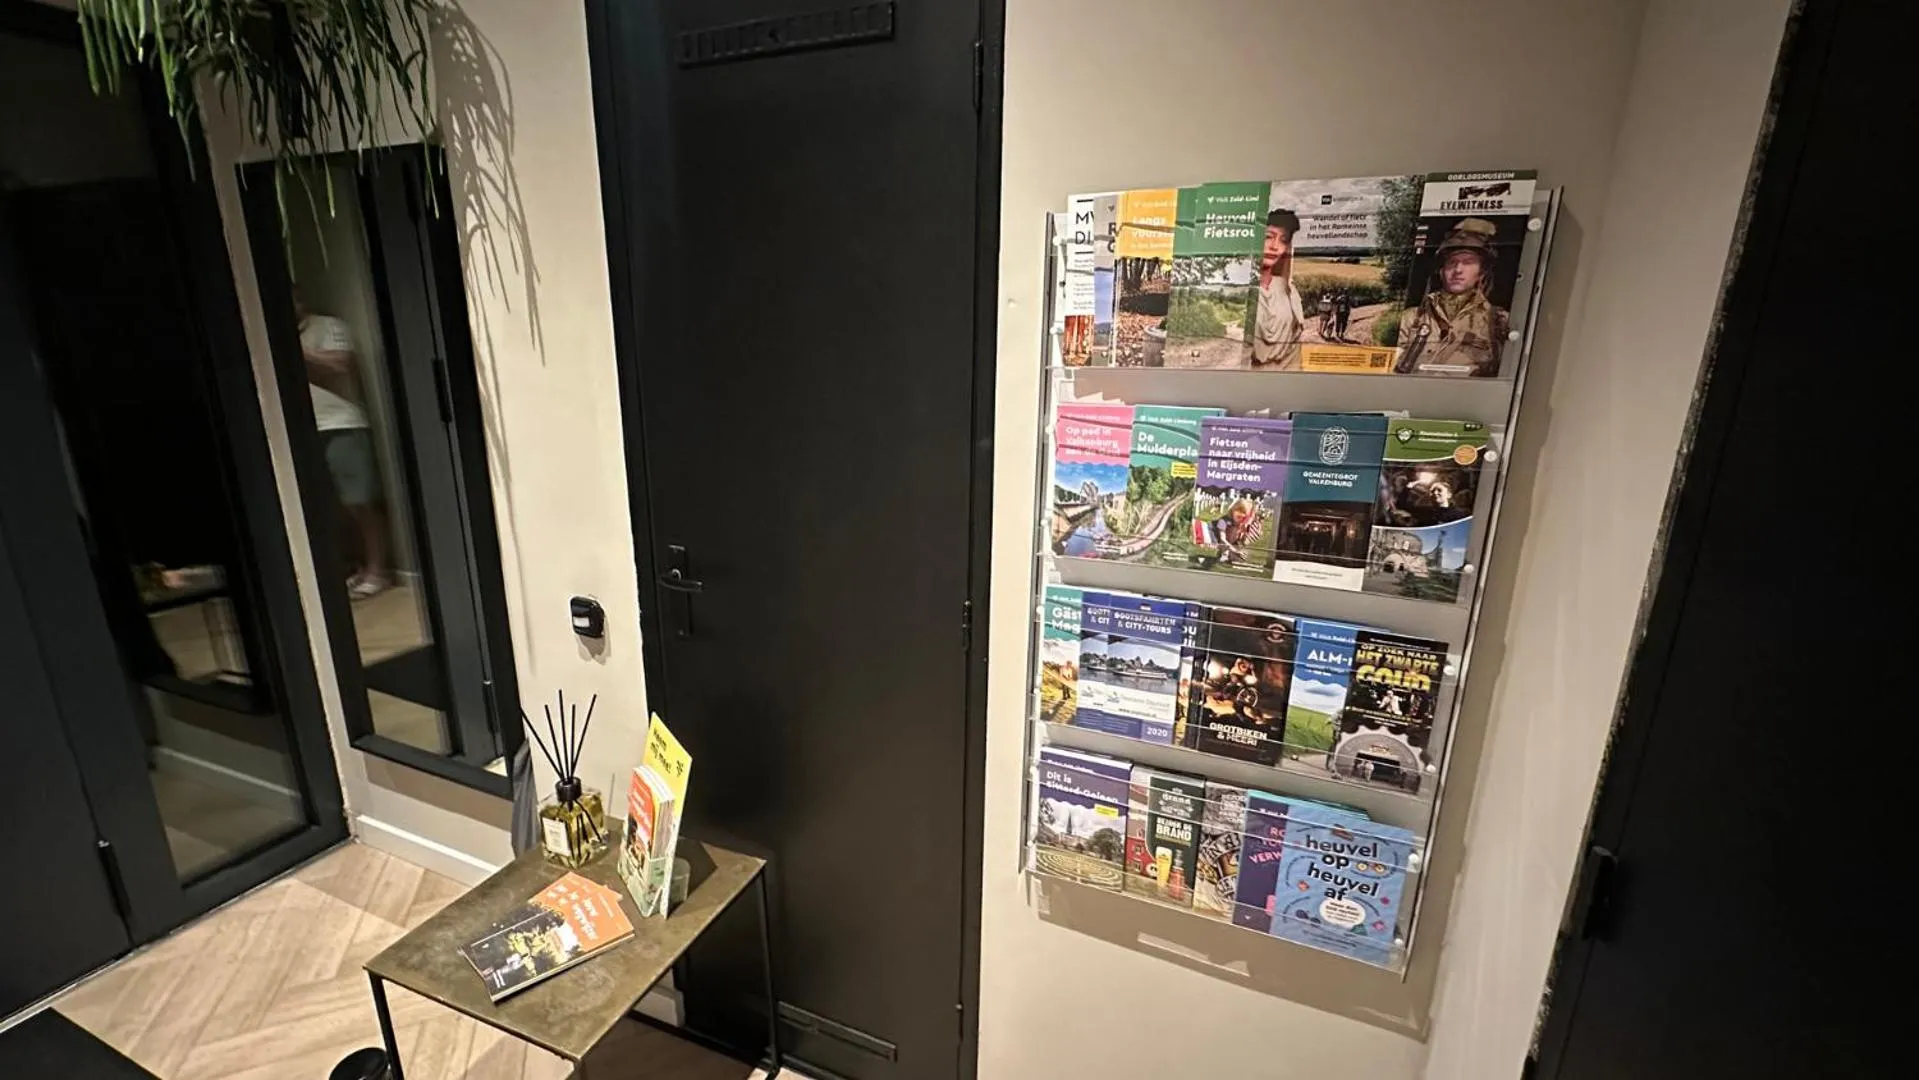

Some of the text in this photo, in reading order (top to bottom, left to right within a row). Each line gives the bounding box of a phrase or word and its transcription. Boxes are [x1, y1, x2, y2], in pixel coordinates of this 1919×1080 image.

[1447, 172, 1516, 181] OORLOGSMUSEUM
[1440, 199, 1504, 211] EYEWITNESS
[1205, 211, 1256, 225] Heuvell
[1138, 431, 1154, 442] De
[1209, 437, 1249, 448] Fietsen
[1137, 443, 1199, 458] Mulderpla
[1208, 449, 1276, 461] naar vrijheid
[1207, 458, 1218, 468] in
[1207, 470, 1261, 482] Margraten
[1302, 470, 1359, 481] GEMEENTEGROT
[1308, 478, 1353, 488] VALKENBURG
[1125, 621, 1172, 635] CITY-TOURS
[1356, 649, 1440, 673] HET ZWARTE
[1406, 650, 1438, 661] NAAR
[1355, 664, 1432, 692] GOUD
[1146, 726, 1169, 738] 2020
[1209, 722, 1268, 741] GROTBIKEN
[1216, 731, 1225, 740] &
[1046, 770, 1072, 784] Dit is
[1156, 823, 1192, 842] BRAND
[1306, 834, 1378, 858] heuvel
[1322, 854, 1350, 870] op
[1307, 861, 1379, 897] heuvel
[1324, 887, 1349, 901] af
